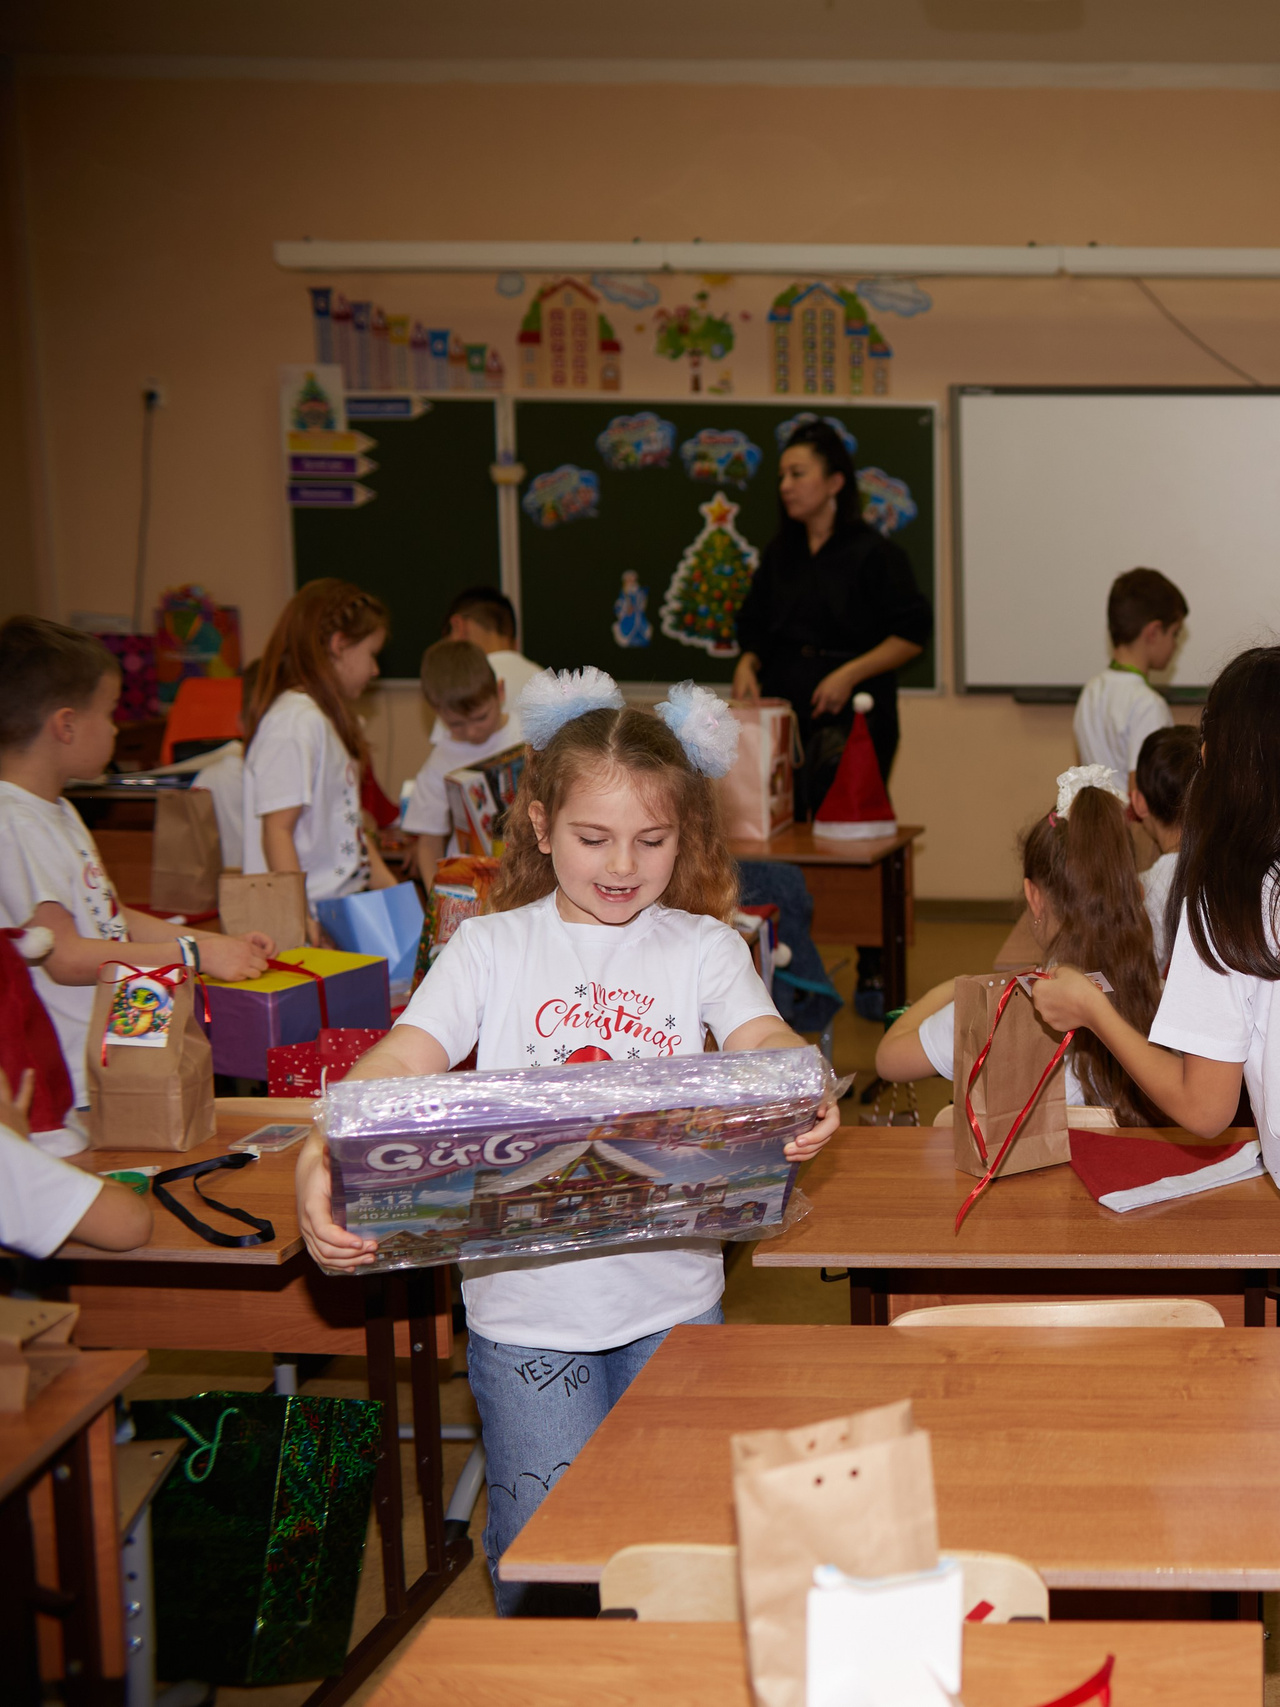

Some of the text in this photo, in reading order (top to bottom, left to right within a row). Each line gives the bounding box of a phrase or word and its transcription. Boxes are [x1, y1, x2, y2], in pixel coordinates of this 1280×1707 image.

[588, 981, 656, 1015] Merry
[535, 998, 682, 1057] Christmas
[366, 1134, 536, 1172] Girls
[358, 1212, 389, 1220] 402
[359, 1194, 413, 1206] 5-12
